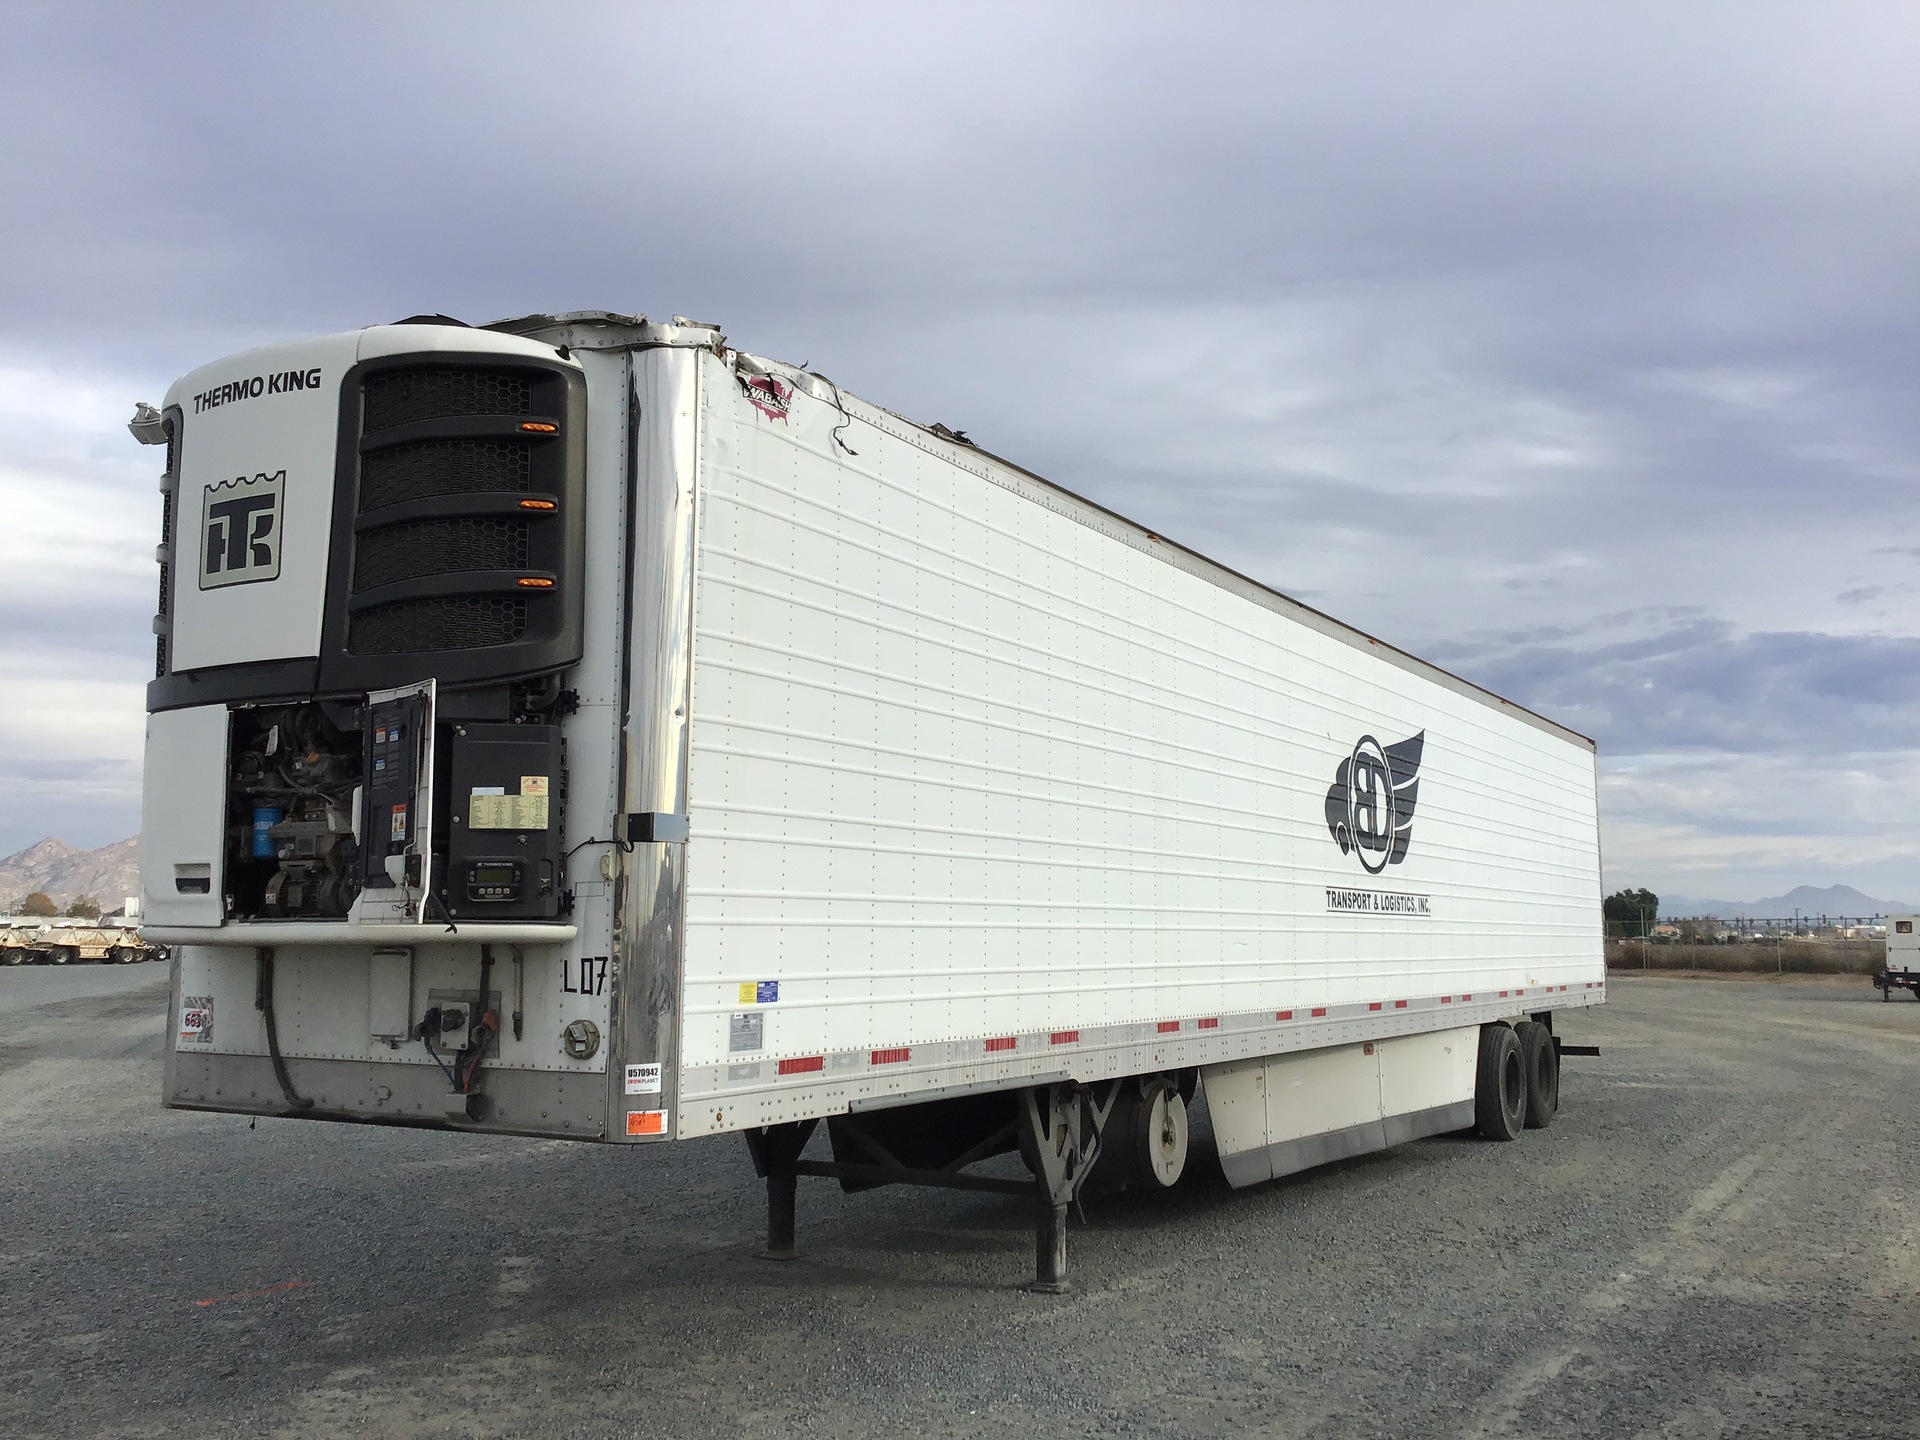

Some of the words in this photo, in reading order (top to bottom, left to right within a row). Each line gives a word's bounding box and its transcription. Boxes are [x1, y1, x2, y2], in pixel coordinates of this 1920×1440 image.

[193, 376, 265, 415] THERMO
[268, 368, 322, 395] KING
[1326, 890, 1372, 910] TRANSPORT
[1373, 894, 1379, 911] &
[1381, 894, 1417, 914] LOGISTICS,
[1418, 897, 1432, 914] INC.
[563, 956, 609, 997] L07
[628, 1067, 659, 1078] U570942
